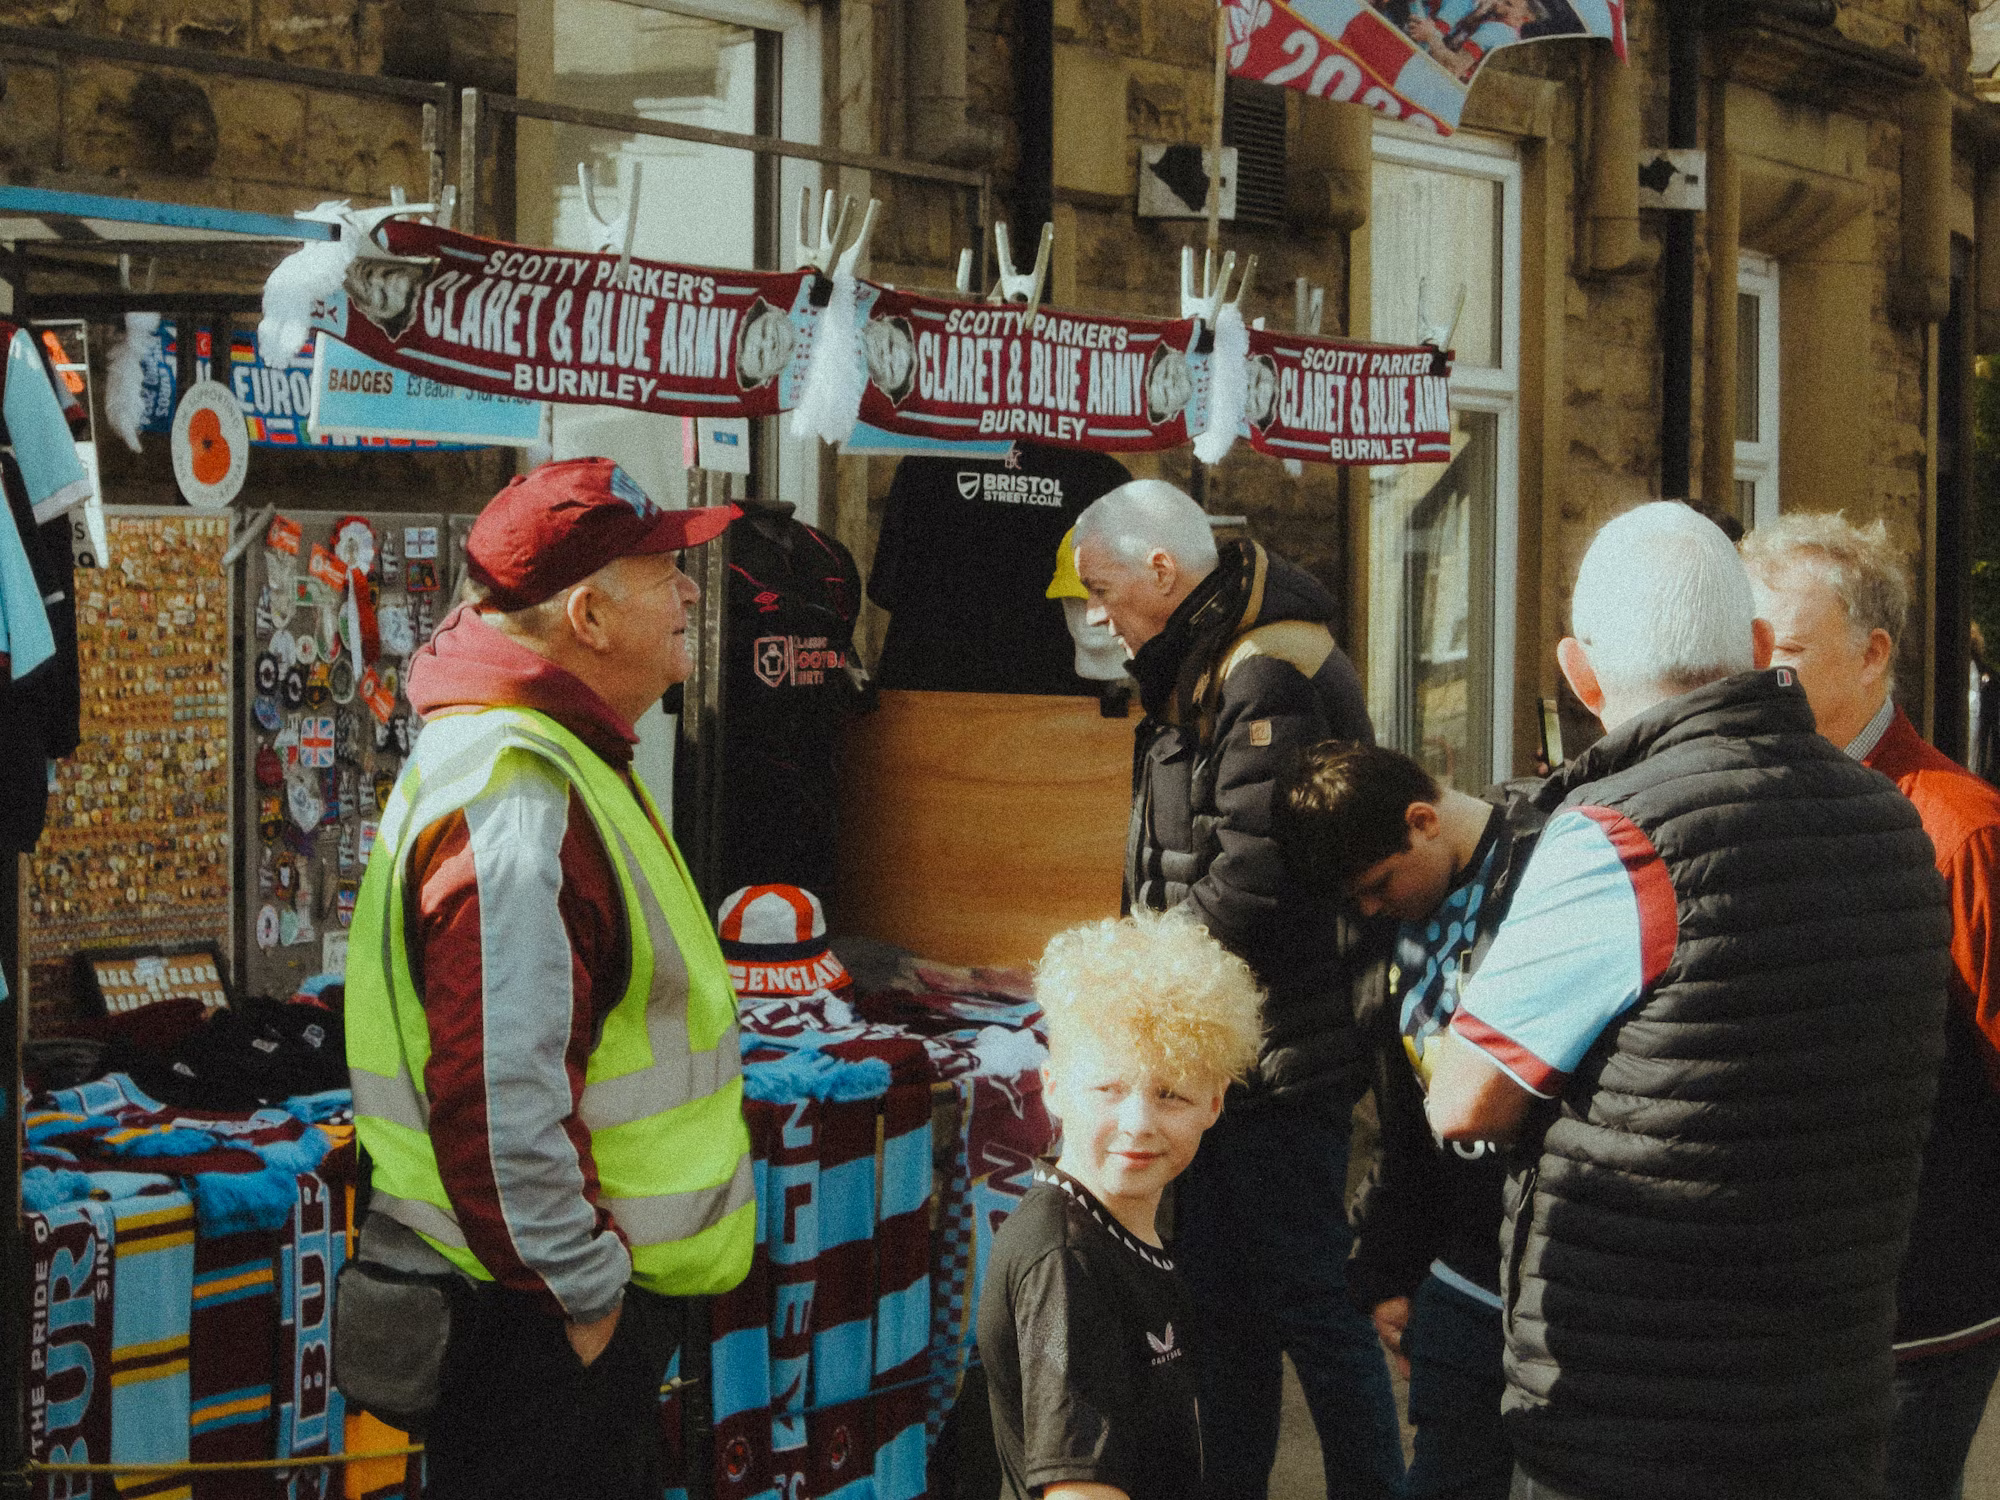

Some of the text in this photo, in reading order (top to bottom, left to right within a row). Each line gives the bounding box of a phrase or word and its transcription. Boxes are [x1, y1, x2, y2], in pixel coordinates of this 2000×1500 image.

[482, 250, 717, 302] SCOTTY PARKER'S
[422, 269, 549, 358] CLARET
[548, 289, 573, 364] &
[581, 291, 654, 372] BLUE
[659, 302, 738, 380] ARMY
[945, 308, 1129, 349] SCOTTY PARKER'S
[918, 331, 1003, 404] CLARET
[1006, 339, 1023, 405] &
[1028, 341, 1081, 413] BLUE
[1087, 352, 1145, 416] ARMY
[1301, 347, 1433, 375] SCOTTY PARKER
[328, 368, 393, 395] BADGES
[513, 364, 658, 404] BURNLEY
[1279, 367, 1347, 433] CLARET
[1350, 377, 1365, 435] &
[1368, 376, 1412, 435] BLUE
[1414, 375, 1450, 433] ARM
[979, 409, 1087, 441] BURNLEY
[1330, 438, 1416, 460] BURNLEY
[983, 473, 1063, 497] BRISTOL
[747, 954, 843, 991] ENGLAN
[31, 1260, 48, 1371] PRIDE
[31, 1384, 45, 1456] THE
